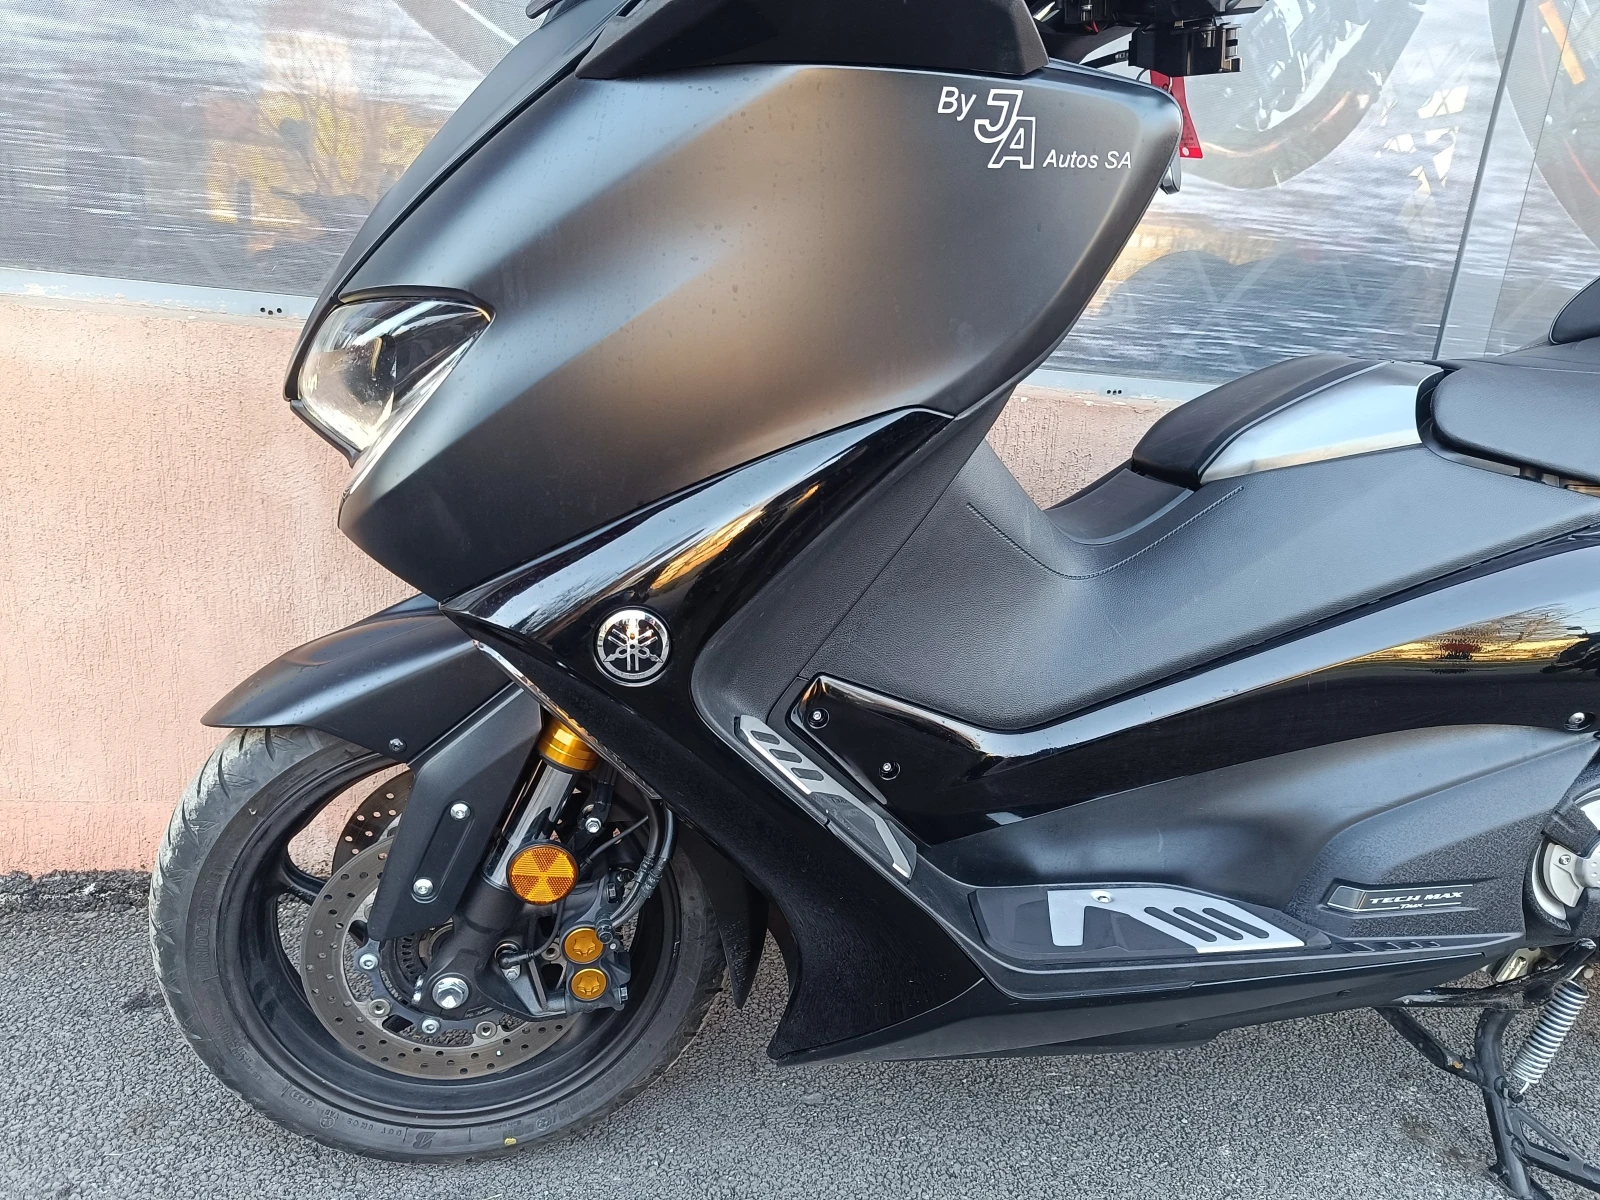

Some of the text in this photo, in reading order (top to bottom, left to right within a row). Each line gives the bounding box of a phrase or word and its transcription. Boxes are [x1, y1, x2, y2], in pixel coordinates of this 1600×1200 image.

[937, 86, 1132, 169] By JA Autos SA
[1369, 891, 1464, 904] TECH MAX
